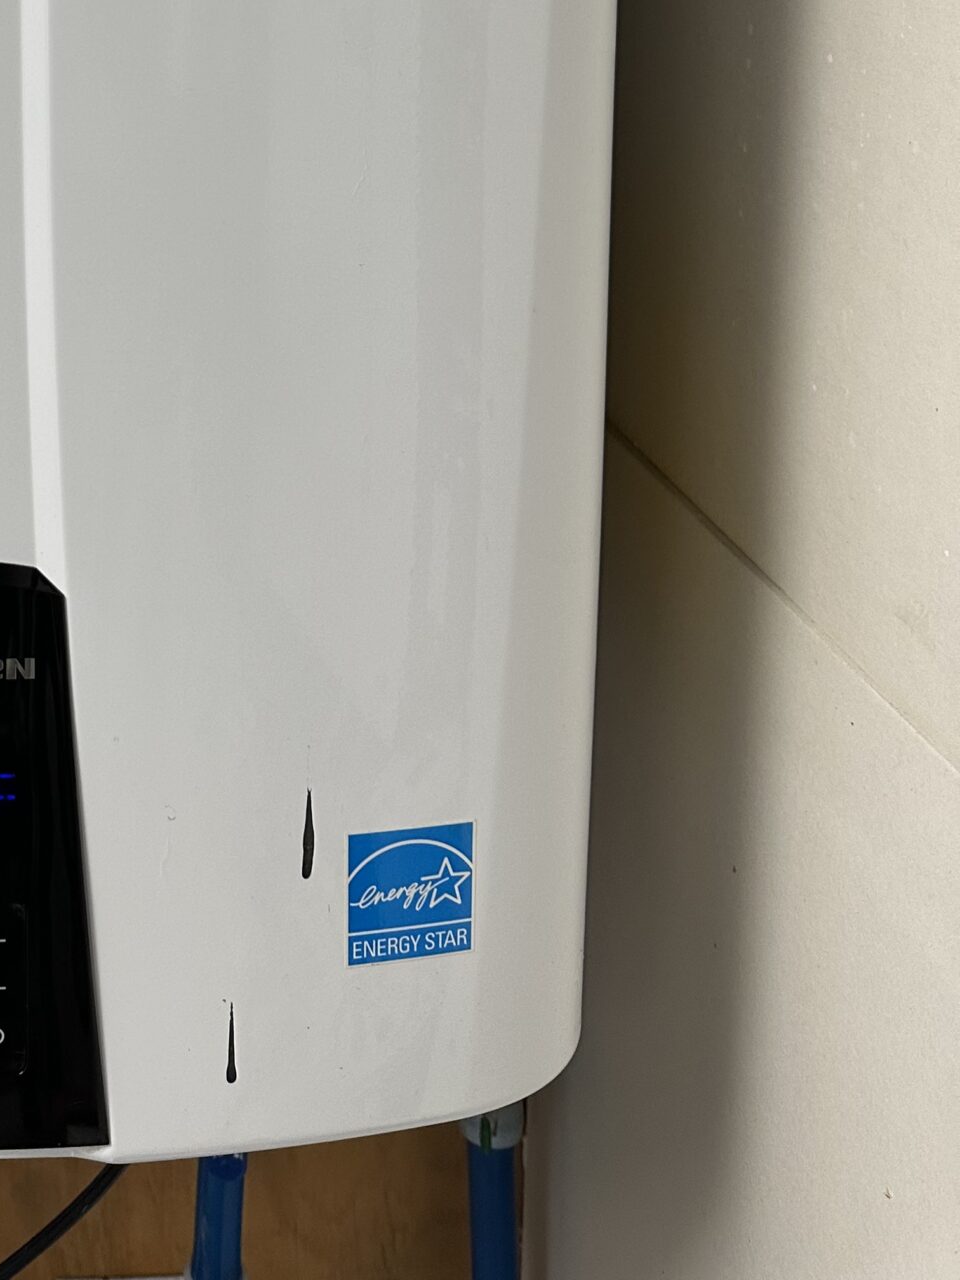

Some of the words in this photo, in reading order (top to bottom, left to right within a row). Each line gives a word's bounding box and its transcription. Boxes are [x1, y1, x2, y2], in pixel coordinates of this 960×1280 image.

[351, 878, 443, 911] energy
[352, 934, 421, 960] ENERGY
[424, 927, 468, 951] STAR
